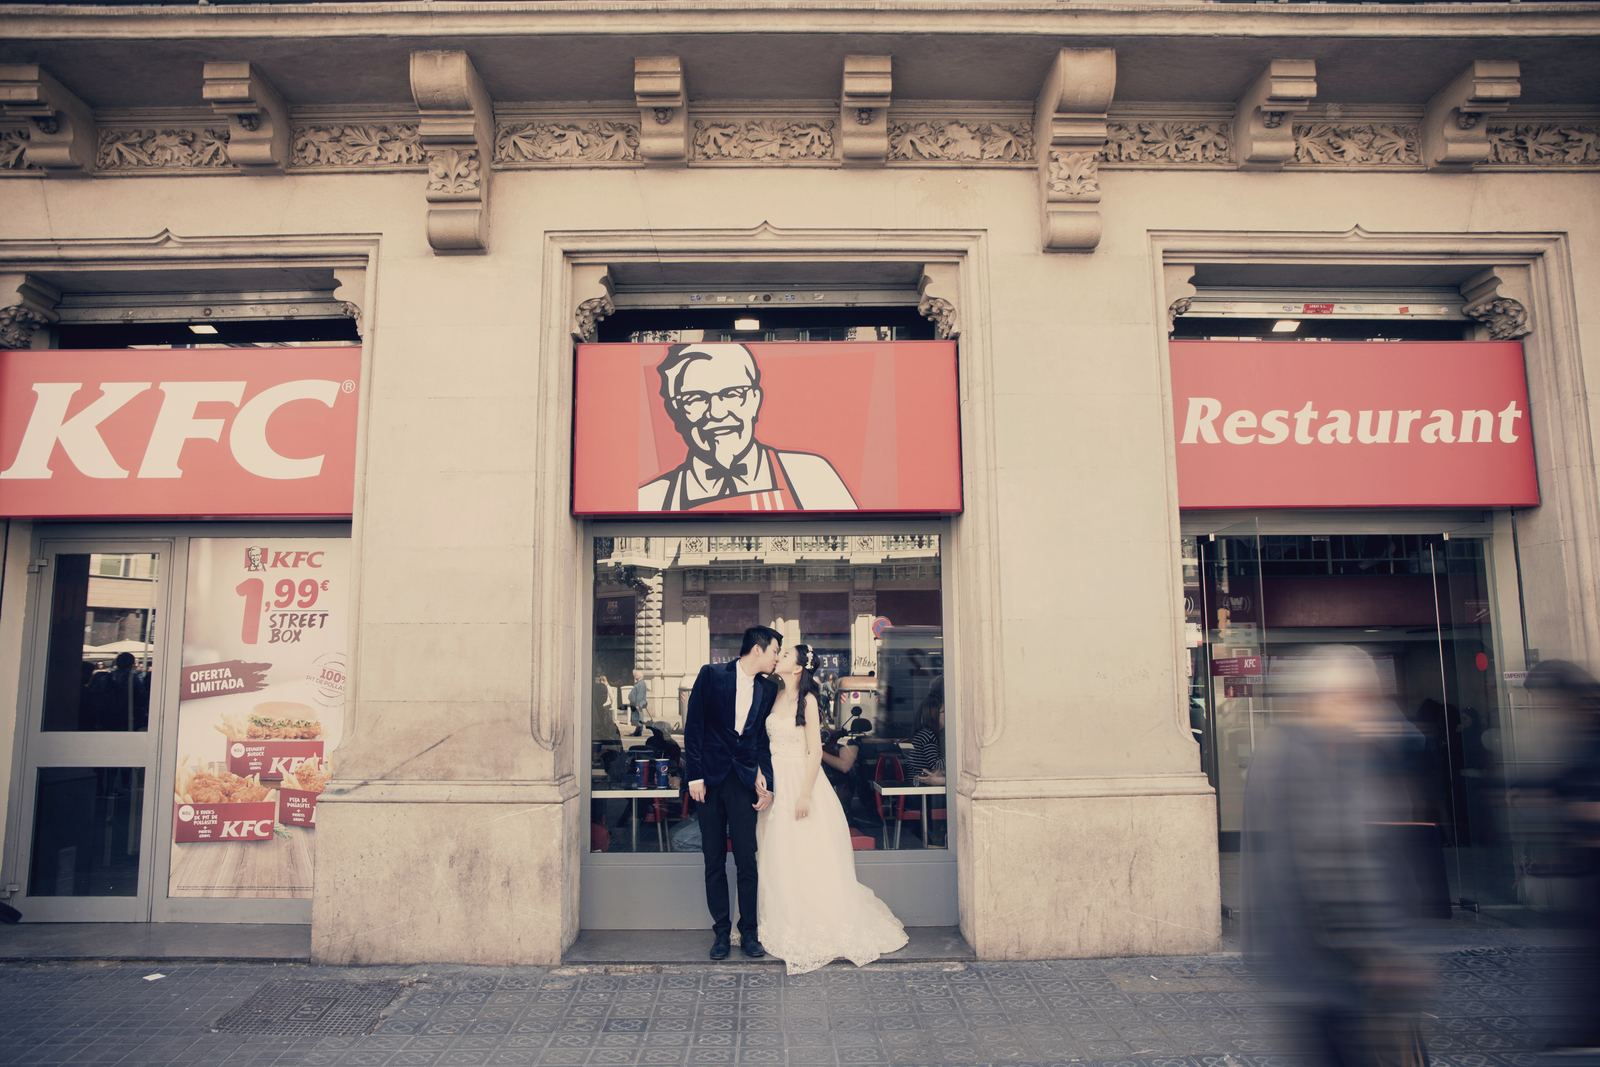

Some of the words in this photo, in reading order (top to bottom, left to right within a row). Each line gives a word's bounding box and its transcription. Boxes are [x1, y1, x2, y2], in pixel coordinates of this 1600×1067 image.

[1180, 397, 1522, 445] Restaurant
[270, 551, 326, 568] KFC
[268, 612, 329, 629] STREET
[267, 628, 302, 644] BOX
[189, 667, 232, 682] OFERTA
[190, 678, 245, 694] LIMITADA
[268, 757, 323, 774] KF
[219, 819, 274, 838] KFC
